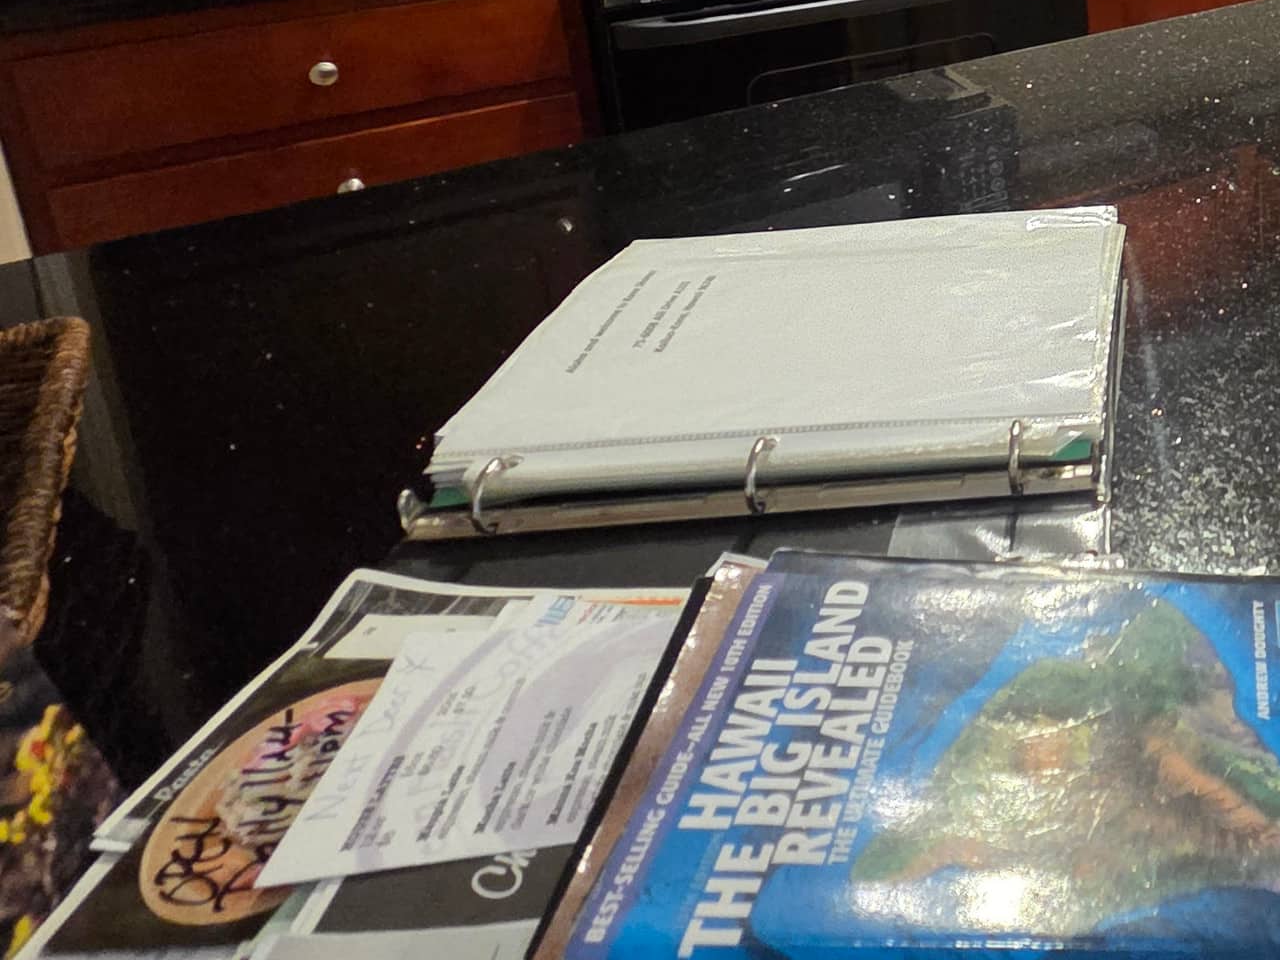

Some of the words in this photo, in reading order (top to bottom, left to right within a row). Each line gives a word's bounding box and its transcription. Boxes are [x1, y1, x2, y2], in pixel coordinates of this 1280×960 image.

[1252, 600, 1267, 659] DOUGHTY
[1255, 661, 1271, 720] ANDREW
[154, 746, 217, 802] Pasta
[299, 751, 375, 823] Next
[584, 808, 666, 943] BEST-SELLING
[702, 676, 730, 713] NEW
[738, 584, 773, 637] EDITION
[678, 659, 798, 829] HAWAII
[678, 843, 776, 959] THE
[734, 742, 814, 827] BIG
[775, 579, 869, 727] ISLAND
[771, 637, 893, 866] REVEALED
[827, 826, 859, 866] THE
[871, 639, 914, 735] GUIDEBOOK
